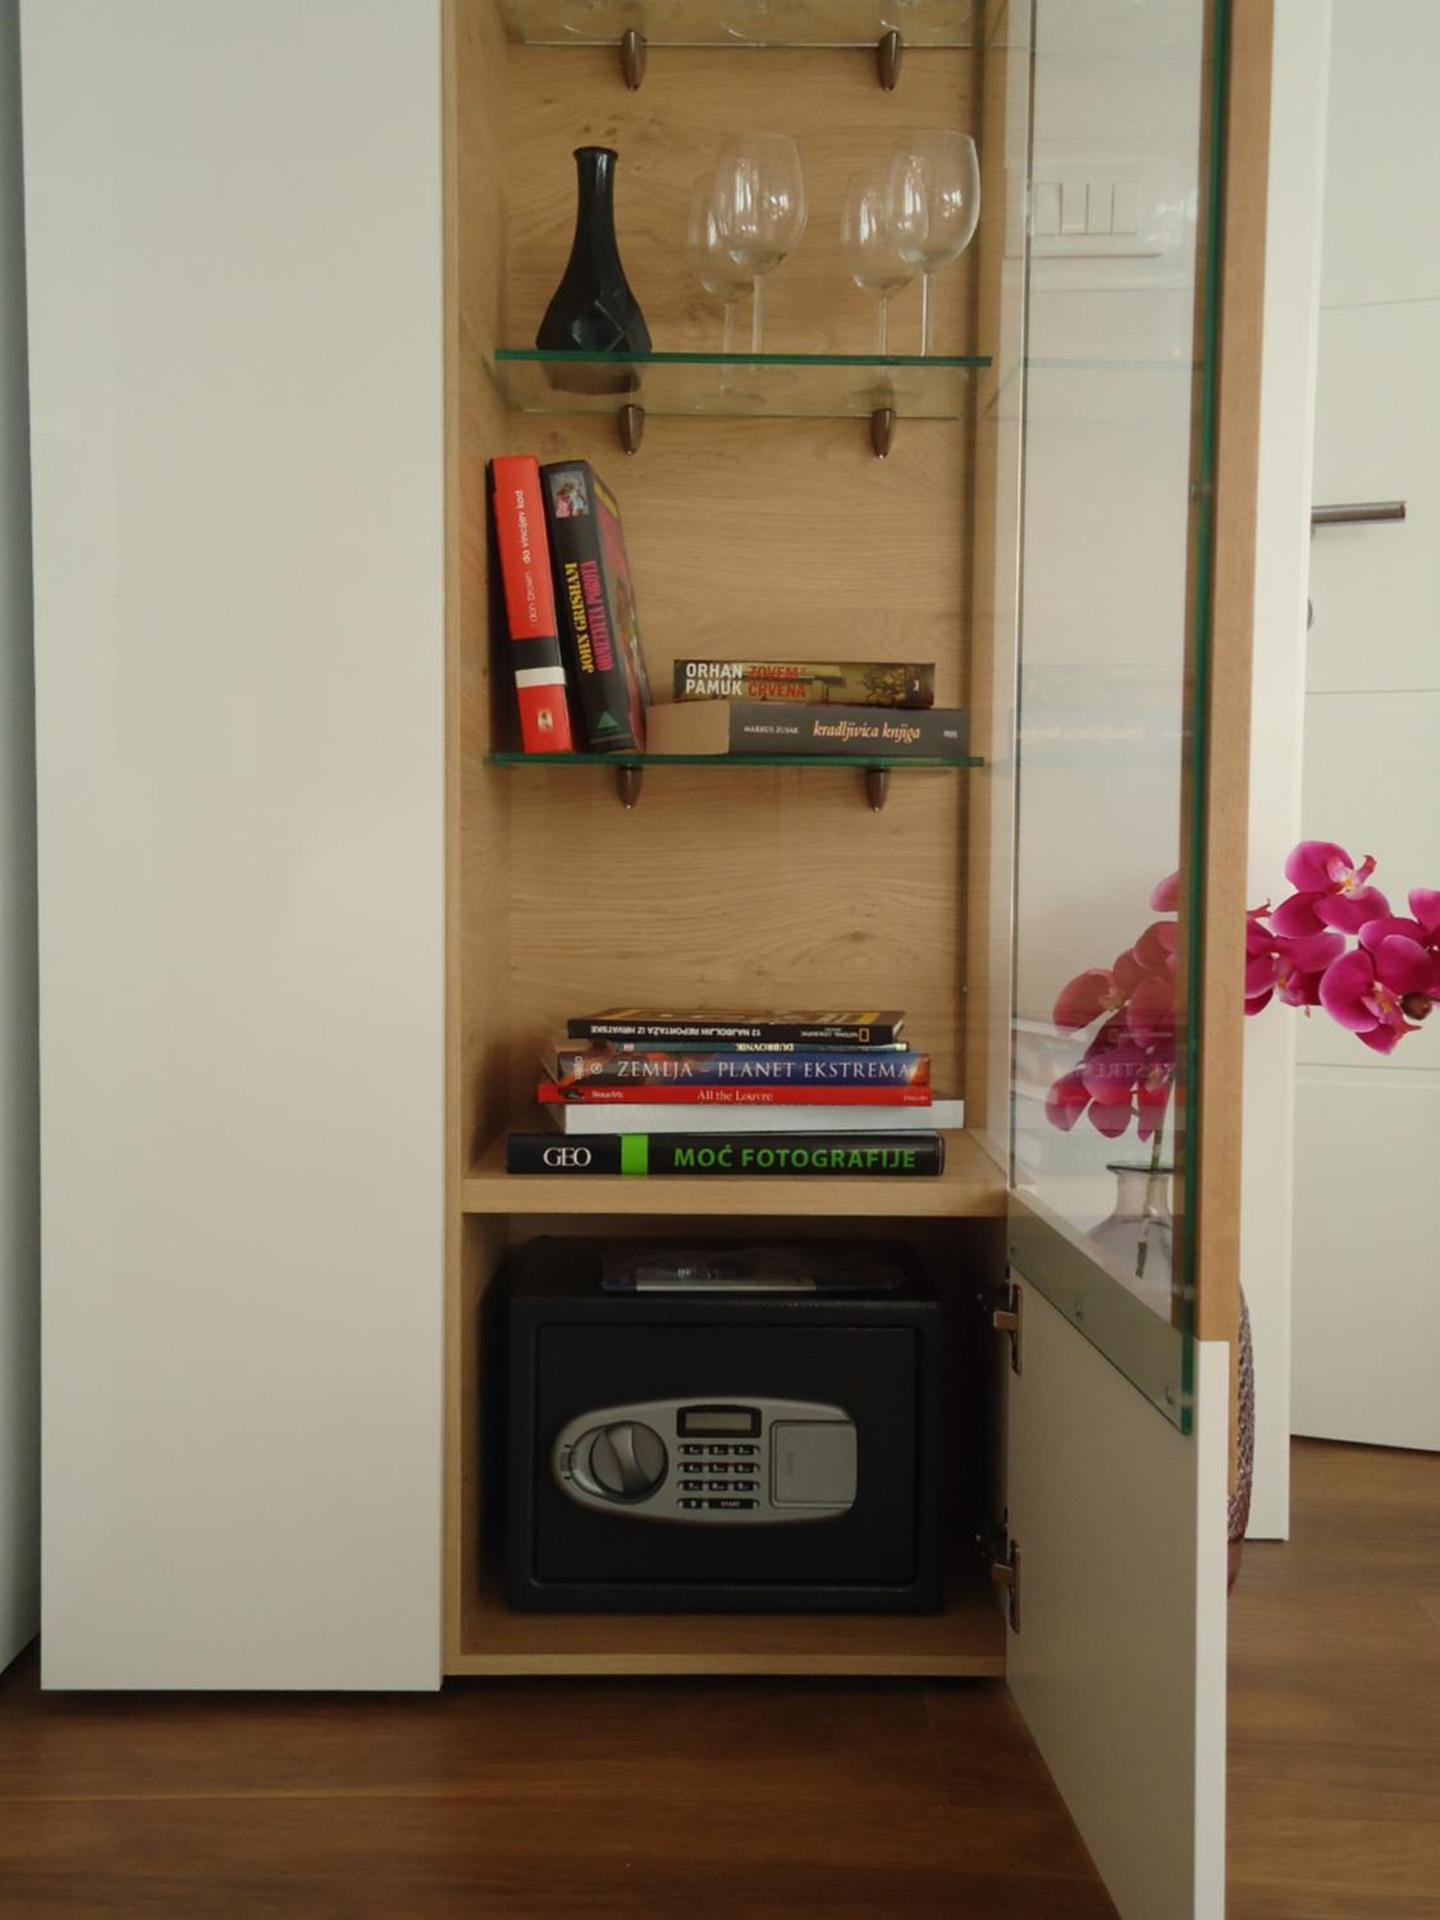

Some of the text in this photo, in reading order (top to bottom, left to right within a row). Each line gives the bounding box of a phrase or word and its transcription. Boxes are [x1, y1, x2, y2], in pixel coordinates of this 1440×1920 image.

[515, 489, 525, 509] kod
[522, 549, 531, 565] da
[525, 570, 537, 623] dan brown
[564, 562, 595, 673] JOHN GRISHAM
[685, 662, 743, 679] ORHAN
[750, 665, 801, 679] ZOVEM
[685, 679, 743, 696] PAMUK
[747, 681, 807, 698] CRVENA
[812, 720, 880, 743] kradljivica
[882, 721, 921, 744] knjiga
[590, 1025, 636, 1034] HRVATSKE
[647, 1025, 700, 1036] REPORTAŽA
[736, 1042, 795, 1052] DUBROVNIK
[617, 1061, 911, 1079] ZEMLJA PLANET EKSTREMA
[696, 1090, 774, 1102] All the Louvre
[542, 1147, 592, 1167] GEO
[673, 1143, 916, 1169] MOĆ FOTOGRAFIJE
